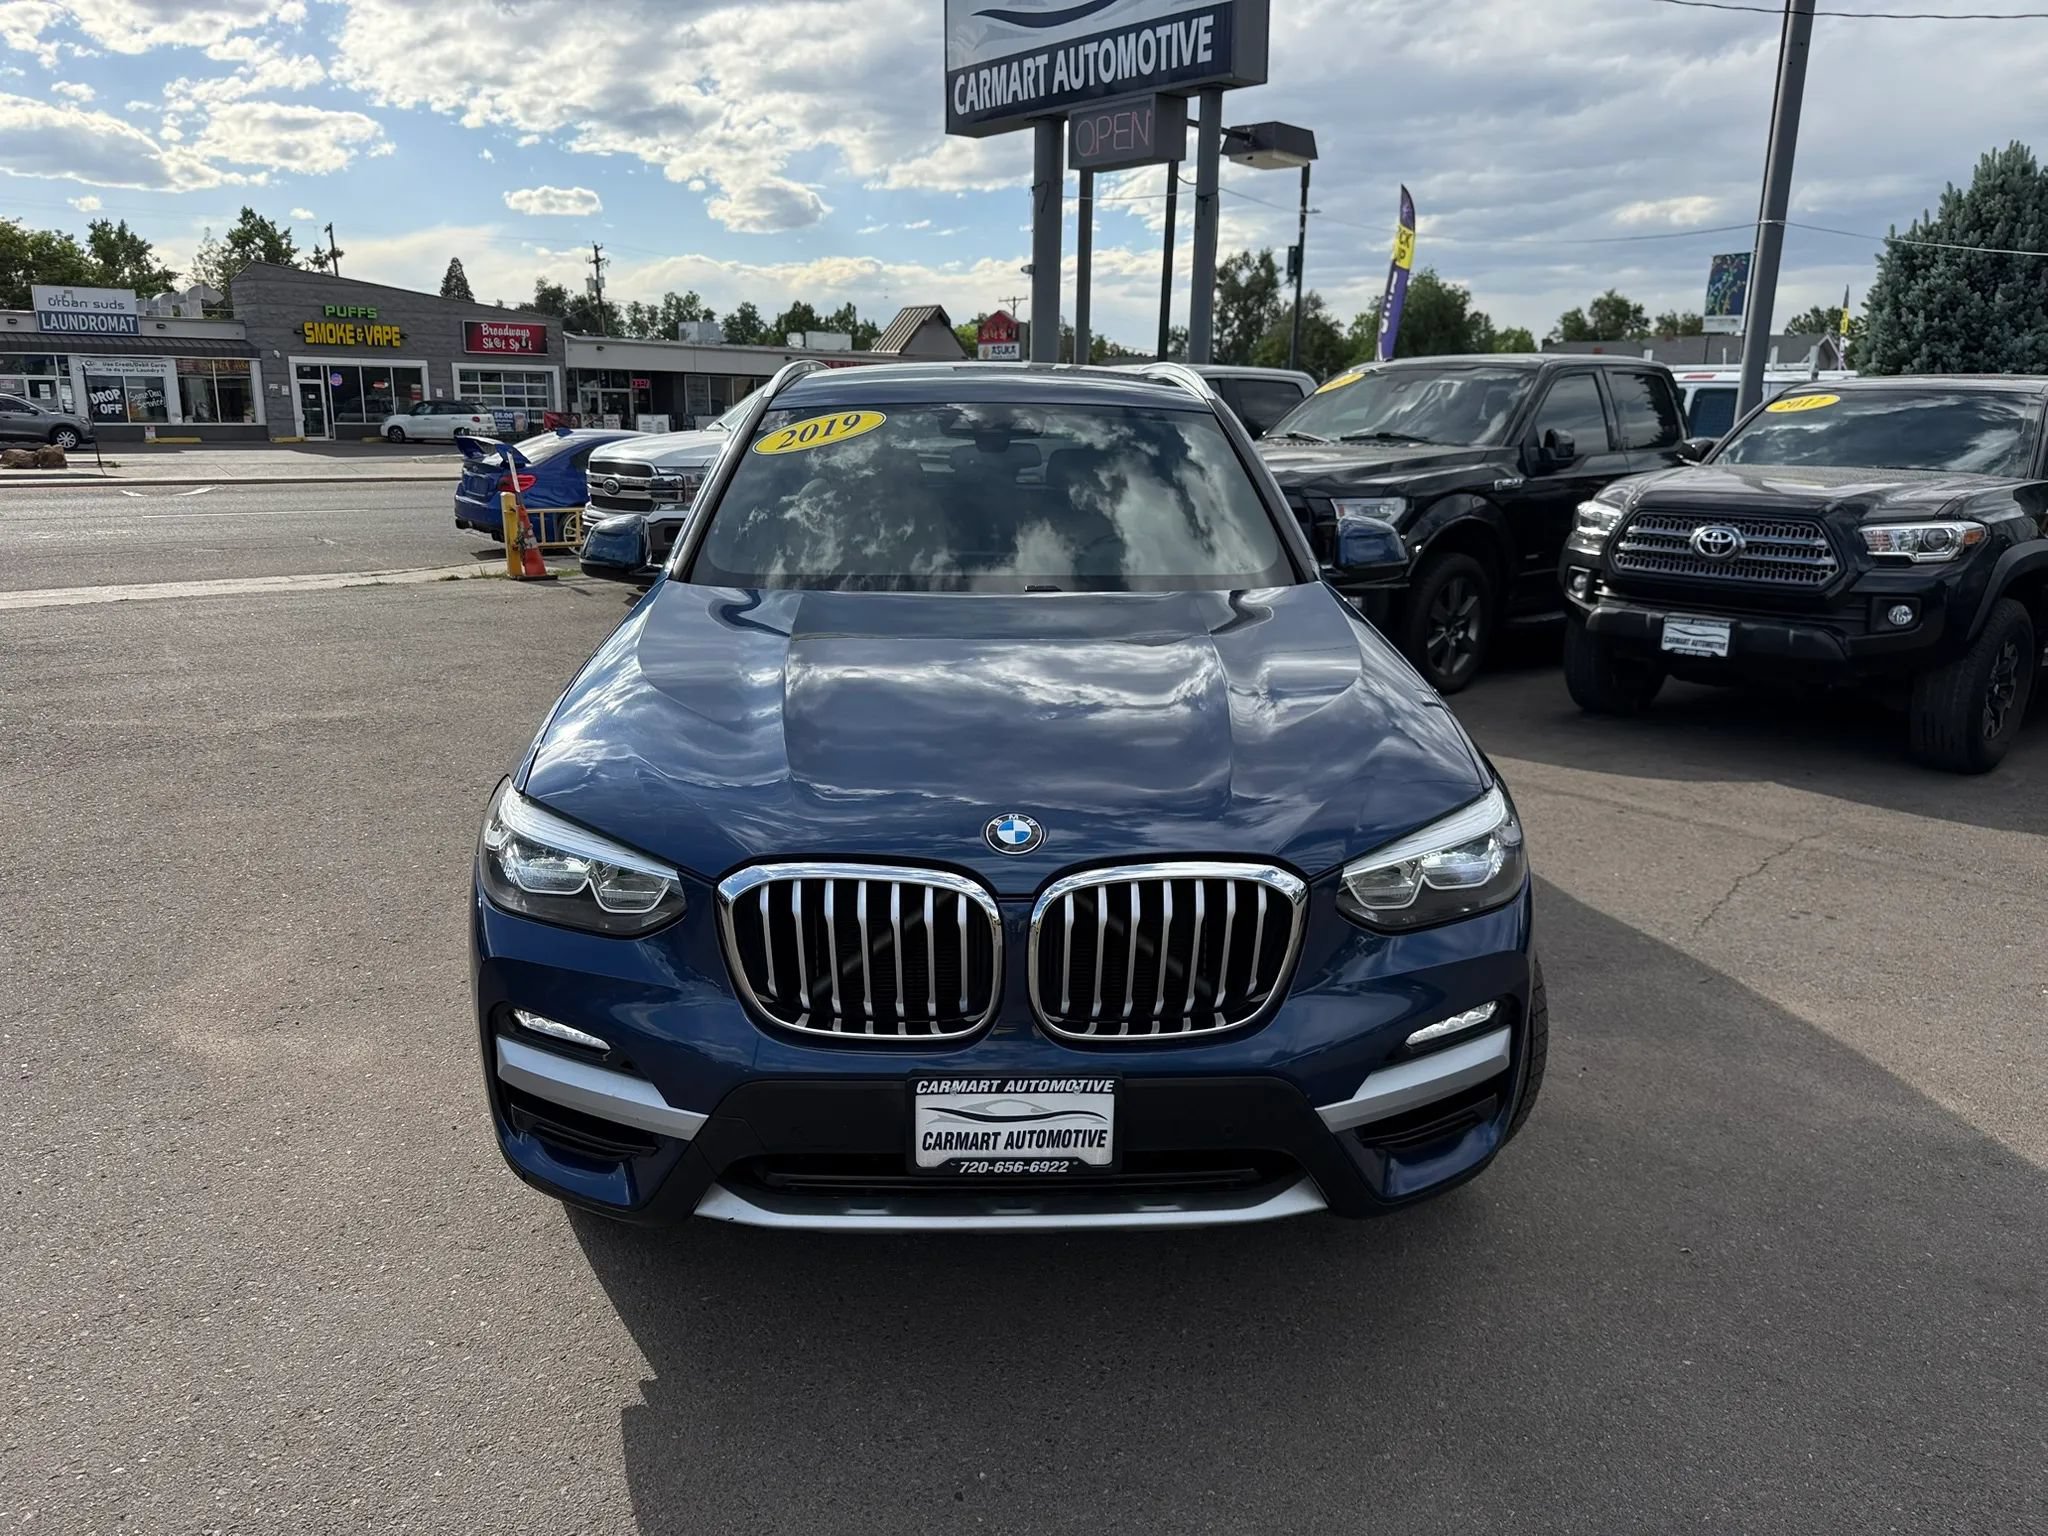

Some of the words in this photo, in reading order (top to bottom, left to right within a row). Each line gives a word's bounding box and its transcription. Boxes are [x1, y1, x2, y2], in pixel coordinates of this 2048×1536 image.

[954, 54, 1048, 115] CARMART
[1052, 14, 1215, 94] AUTOMOTIVE
[1075, 110, 1151, 158] OPEN
[48, 294, 88, 309] urban
[93, 299, 125, 310] suds
[324, 305, 378, 319] PUFFS
[41, 313, 135, 332] LAUNDROMAT
[303, 321, 355, 345] SMOKE
[356, 327, 364, 342] &
[364, 324, 401, 347] VAPE
[481, 323, 531, 338] Broadways
[992, 345, 1016, 355] ASUKA
[89, 388, 121, 405] DROP
[129, 391, 148, 402] Same
[100, 403, 123, 415] OFF
[775, 414, 861, 450] 2019
[991, 814, 1037, 826] BMW
[916, 1080, 1001, 1094] CARMART
[1003, 1079, 1115, 1093] AUTOMOTIVE
[922, 1132, 1001, 1151] CARMART
[1003, 1129, 1108, 1150] AUTOMOTIVE
[959, 1160, 1069, 1174] 720-656-6922
